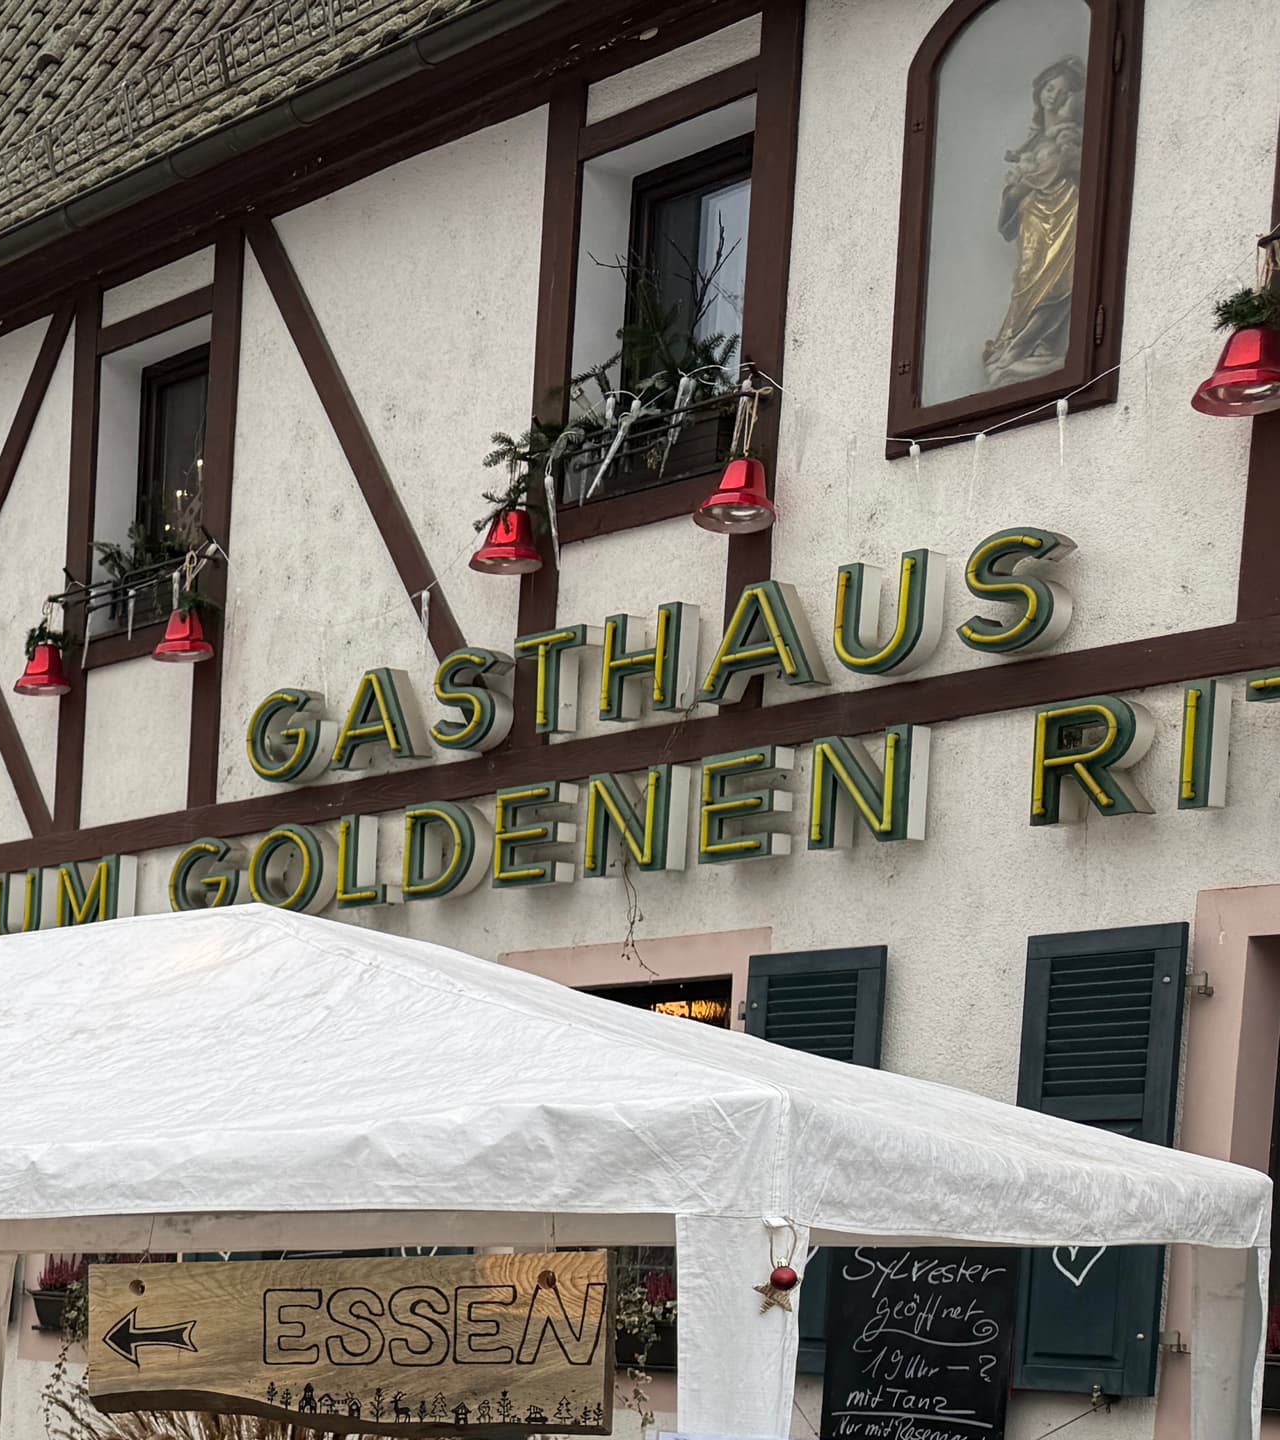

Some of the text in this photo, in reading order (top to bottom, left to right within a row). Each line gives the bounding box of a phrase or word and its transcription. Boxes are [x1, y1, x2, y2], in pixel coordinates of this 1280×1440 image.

[246, 526, 1077, 786] GASTHAUS
[169, 724, 930, 915] GOLDENEN
[262, 1283, 608, 1366] ESSEN
[863, 1293, 984, 1341] geöffnet
[833, 1416, 861, 1437] Nur
[864, 1418, 892, 1438] mit
[846, 1385, 976, 1414] mit Tanz
